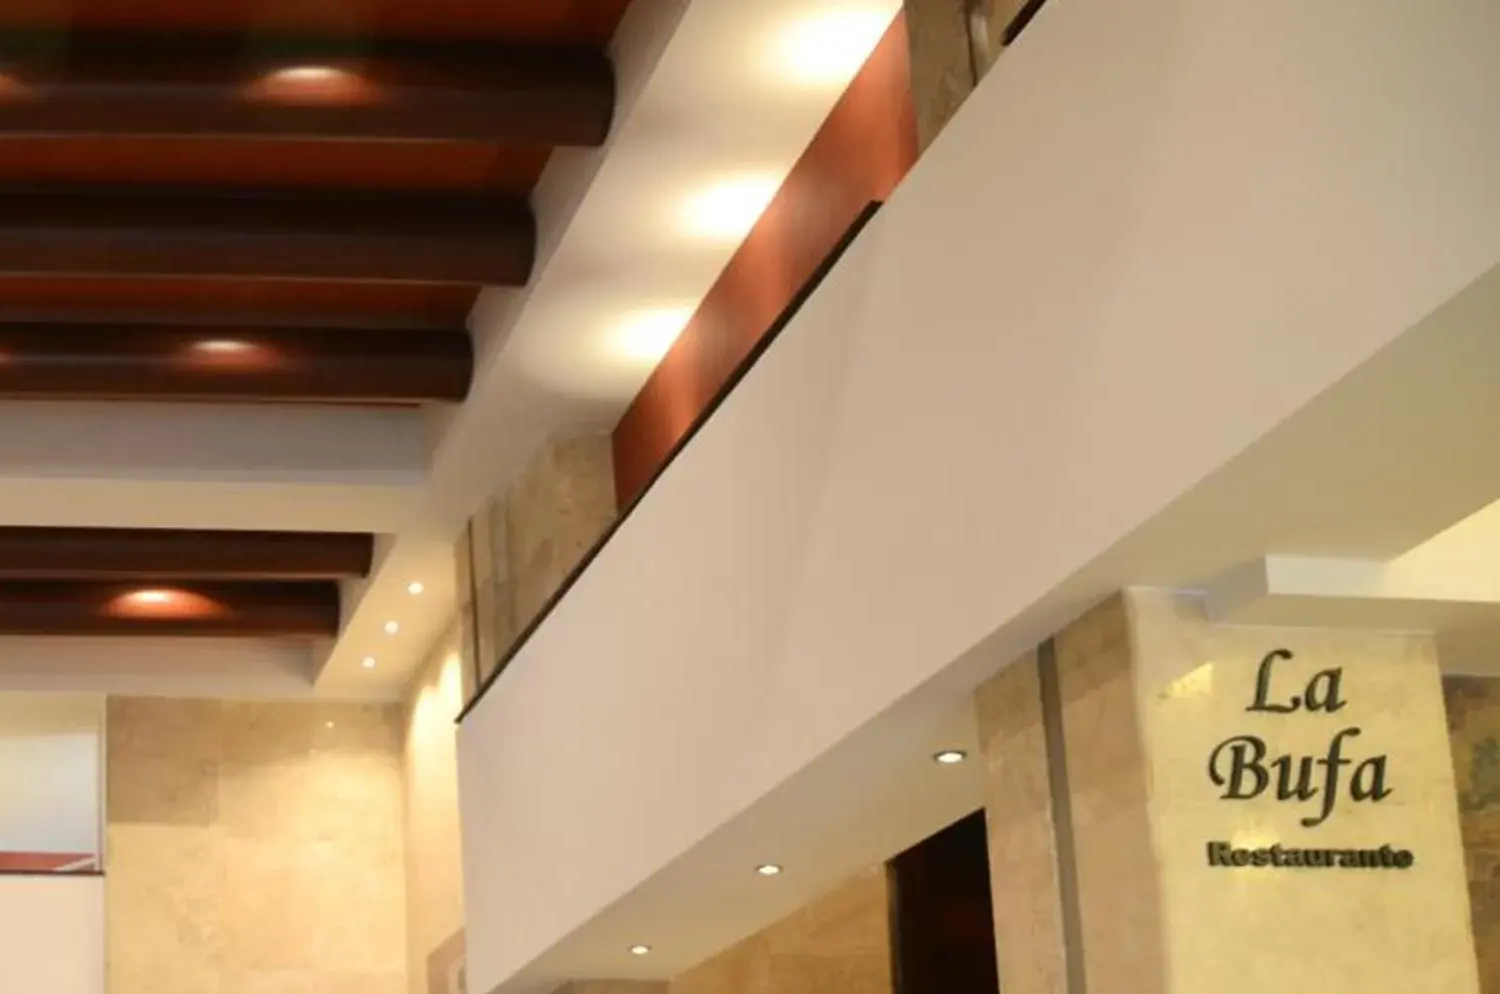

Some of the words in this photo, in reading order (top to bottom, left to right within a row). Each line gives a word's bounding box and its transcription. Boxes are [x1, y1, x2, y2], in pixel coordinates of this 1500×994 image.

[1245, 648, 1347, 714] La
[1208, 727, 1393, 828] Bufa
[1207, 840, 1414, 869] Restaurante
